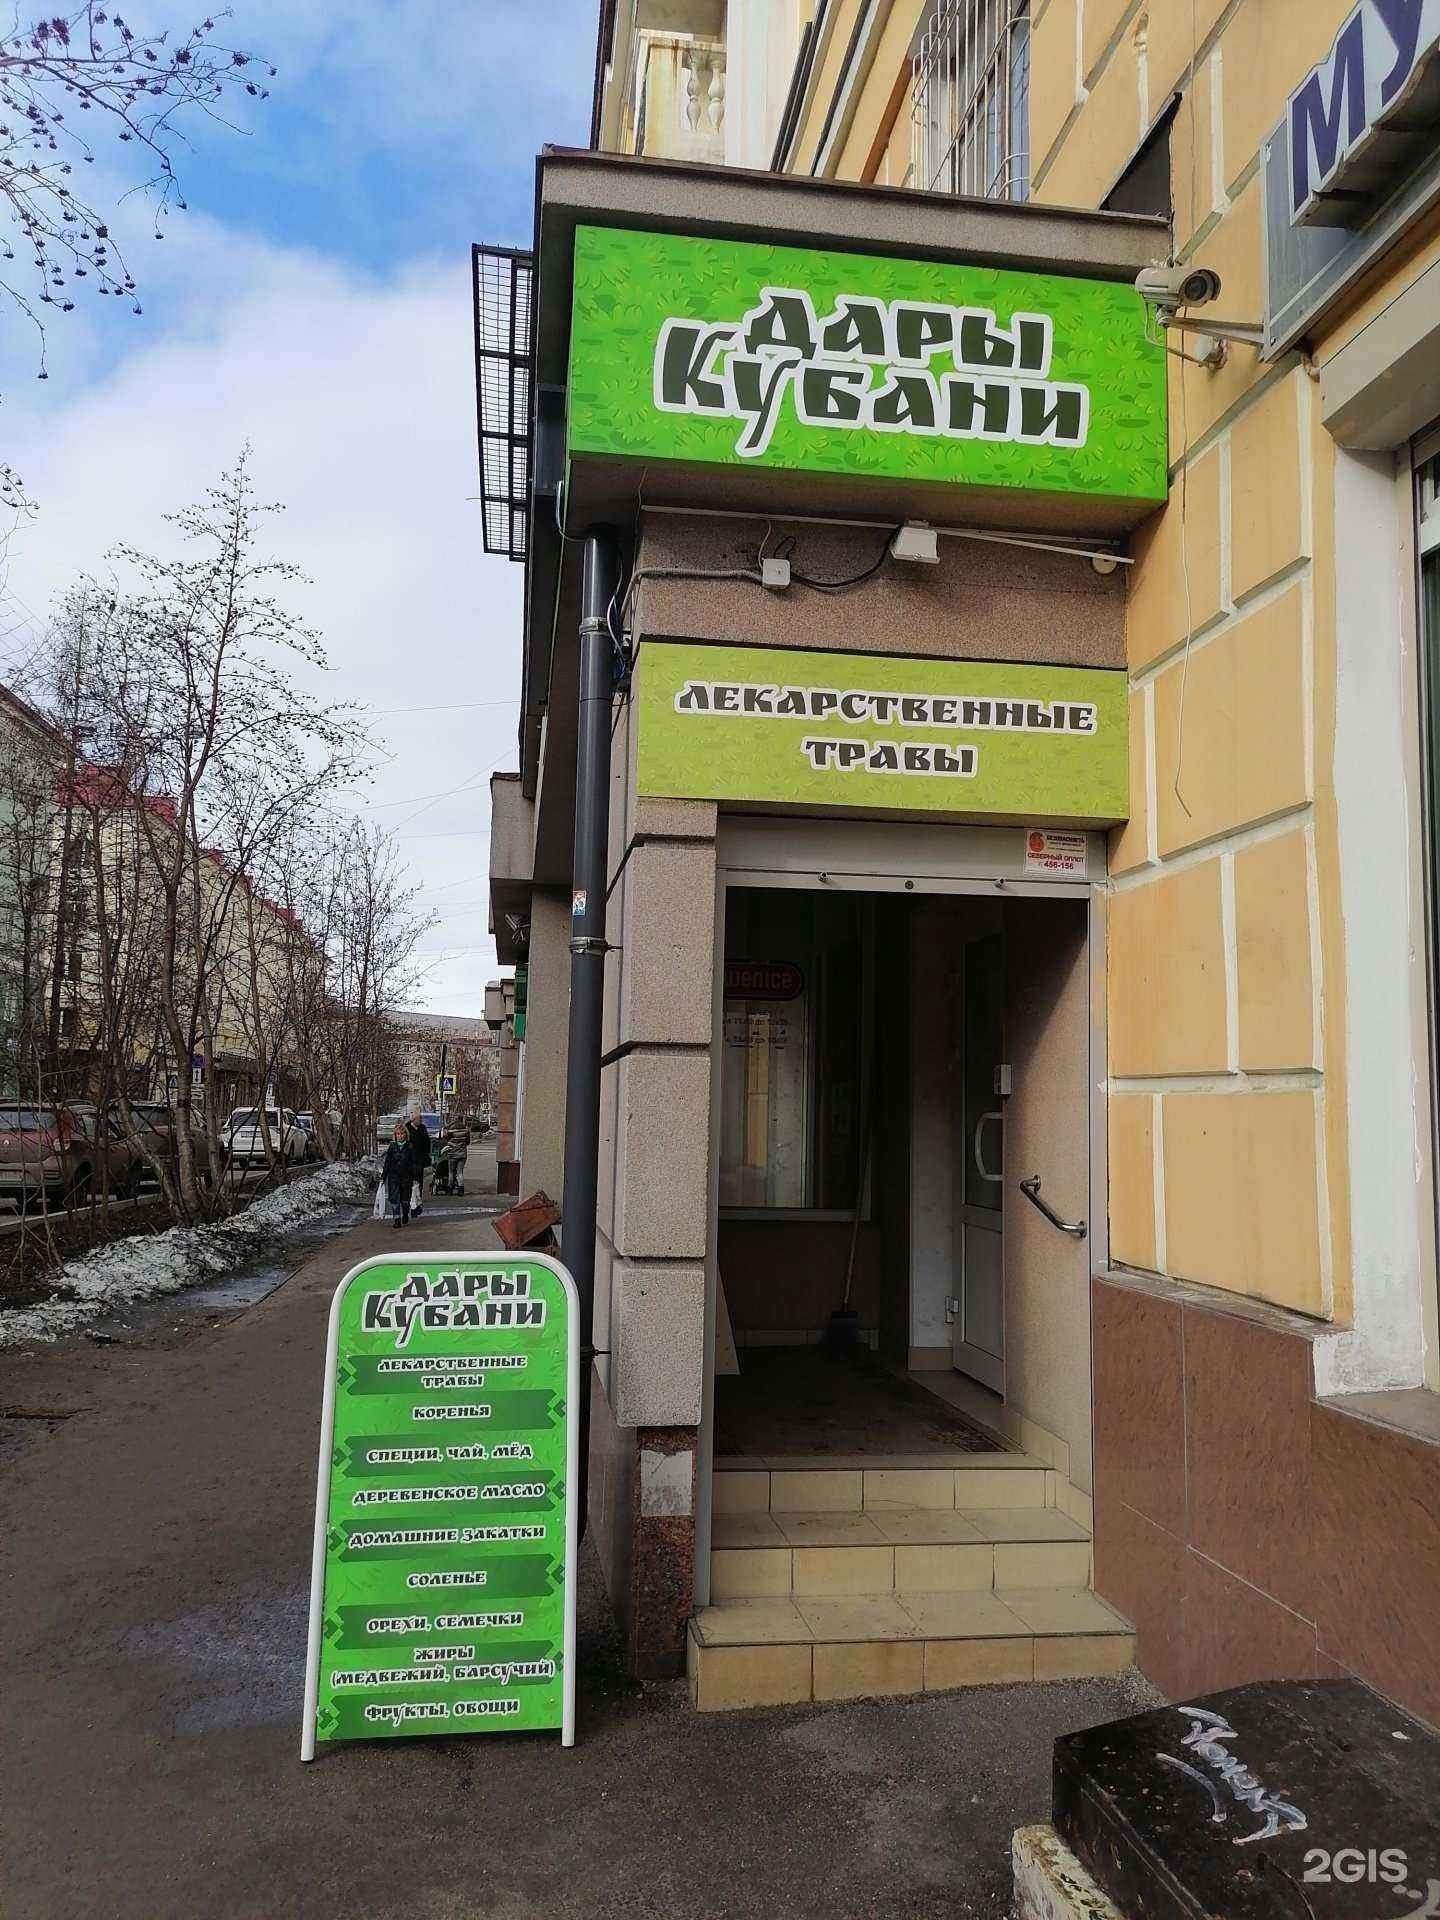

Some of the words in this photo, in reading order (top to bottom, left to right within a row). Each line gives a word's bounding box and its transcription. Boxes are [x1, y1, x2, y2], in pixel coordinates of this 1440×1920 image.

[742, 292, 1048, 373] ДАРЫ
[658, 322, 1088, 452] КУБАНИ
[677, 683, 1095, 732] ЛЕКАРСТВЕННЫЕ
[804, 739, 976, 775] ТРАВЫ
[398, 1272, 530, 1300] ДАРЫ
[363, 1292, 544, 1346] КУБАНИ
[378, 1356, 527, 1372] ЛЕКАРСТВЕННЫЕ
[422, 1375, 483, 1388] ТРАВЫ
[413, 1405, 491, 1420] КОРЕНЬЯ
[366, 1448, 443, 1463] СПЕЦИИ,
[448, 1445, 487, 1460] ЧАЙ,
[493, 1443, 533, 1458] МЁД
[353, 1486, 477, 1506] ДЕРЕВЕНСКОЕ
[482, 1484, 545, 1498] МАСЛО
[349, 1530, 458, 1548] ДОМАШНИЕ
[462, 1526, 546, 1543] ЗАКАТКИ
[407, 1572, 486, 1588] СОЛЕНЬЕ
[367, 1618, 430, 1634] ОРЕХИ,
[436, 1613, 523, 1629] СЕМЕЧКИ
[415, 1645, 474, 1661] ЖИРЫ
[331, 1666, 449, 1686] (МЕДВЕЖИЙ,
[455, 1660, 554, 1684] БАРСУЧИЙ)
[365, 1704, 449, 1727] ФРУКТЫ,
[454, 1700, 520, 1716] ОВОЩИ
